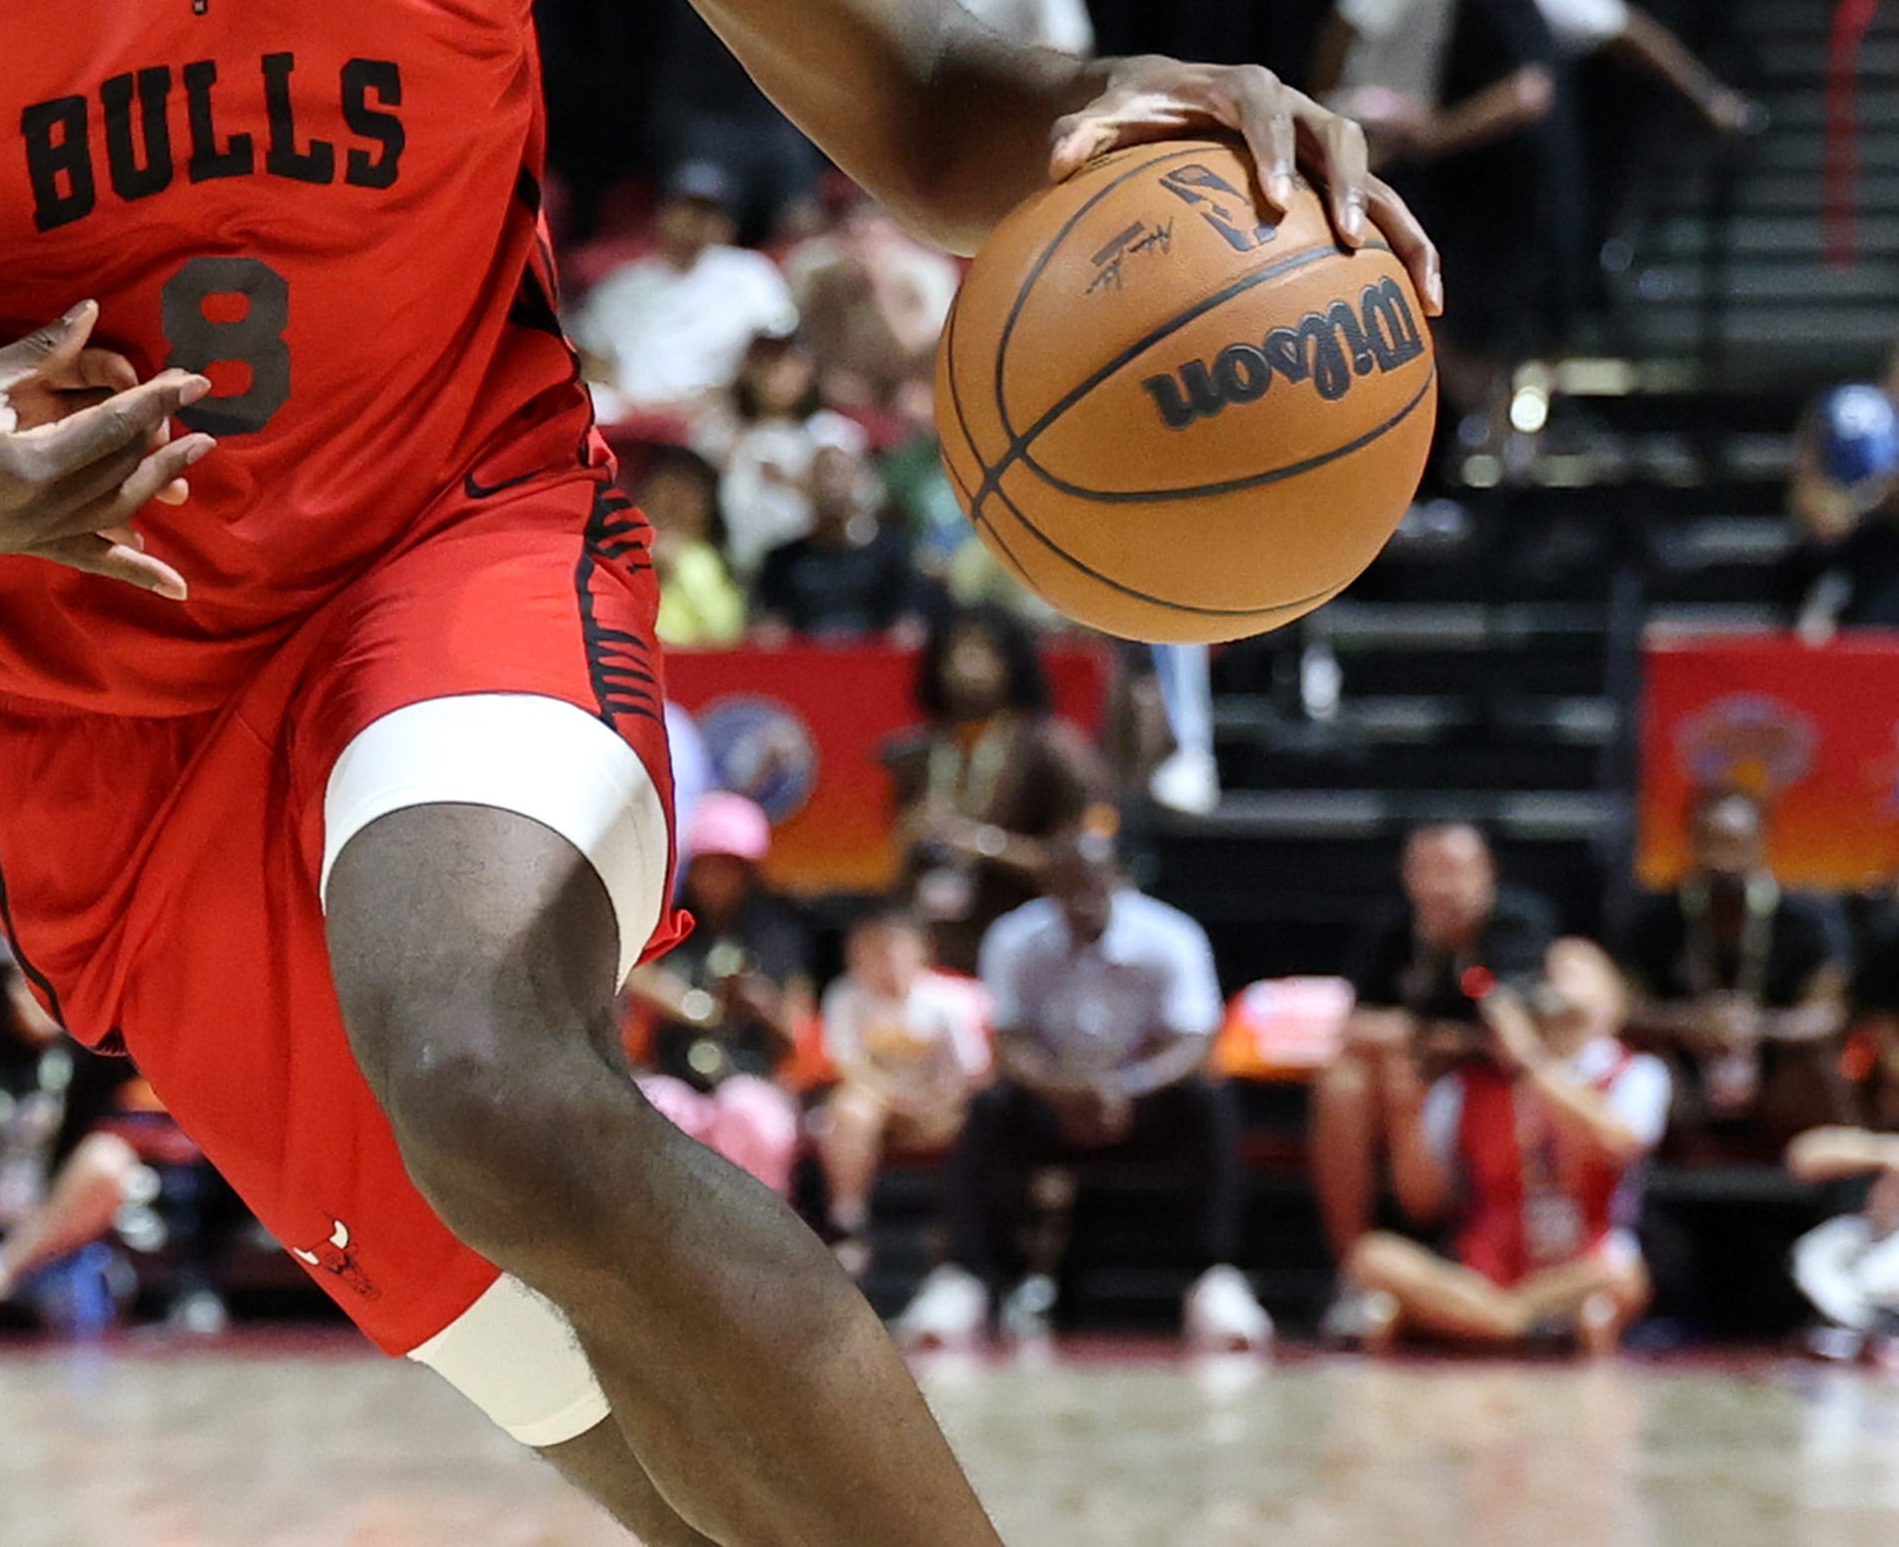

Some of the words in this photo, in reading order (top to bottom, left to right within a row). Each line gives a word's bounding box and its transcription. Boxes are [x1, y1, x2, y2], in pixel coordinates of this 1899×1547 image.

[21, 52, 406, 232] BULLS
[161, 256, 292, 437] 8
[1141, 275, 1425, 431] Wilson
